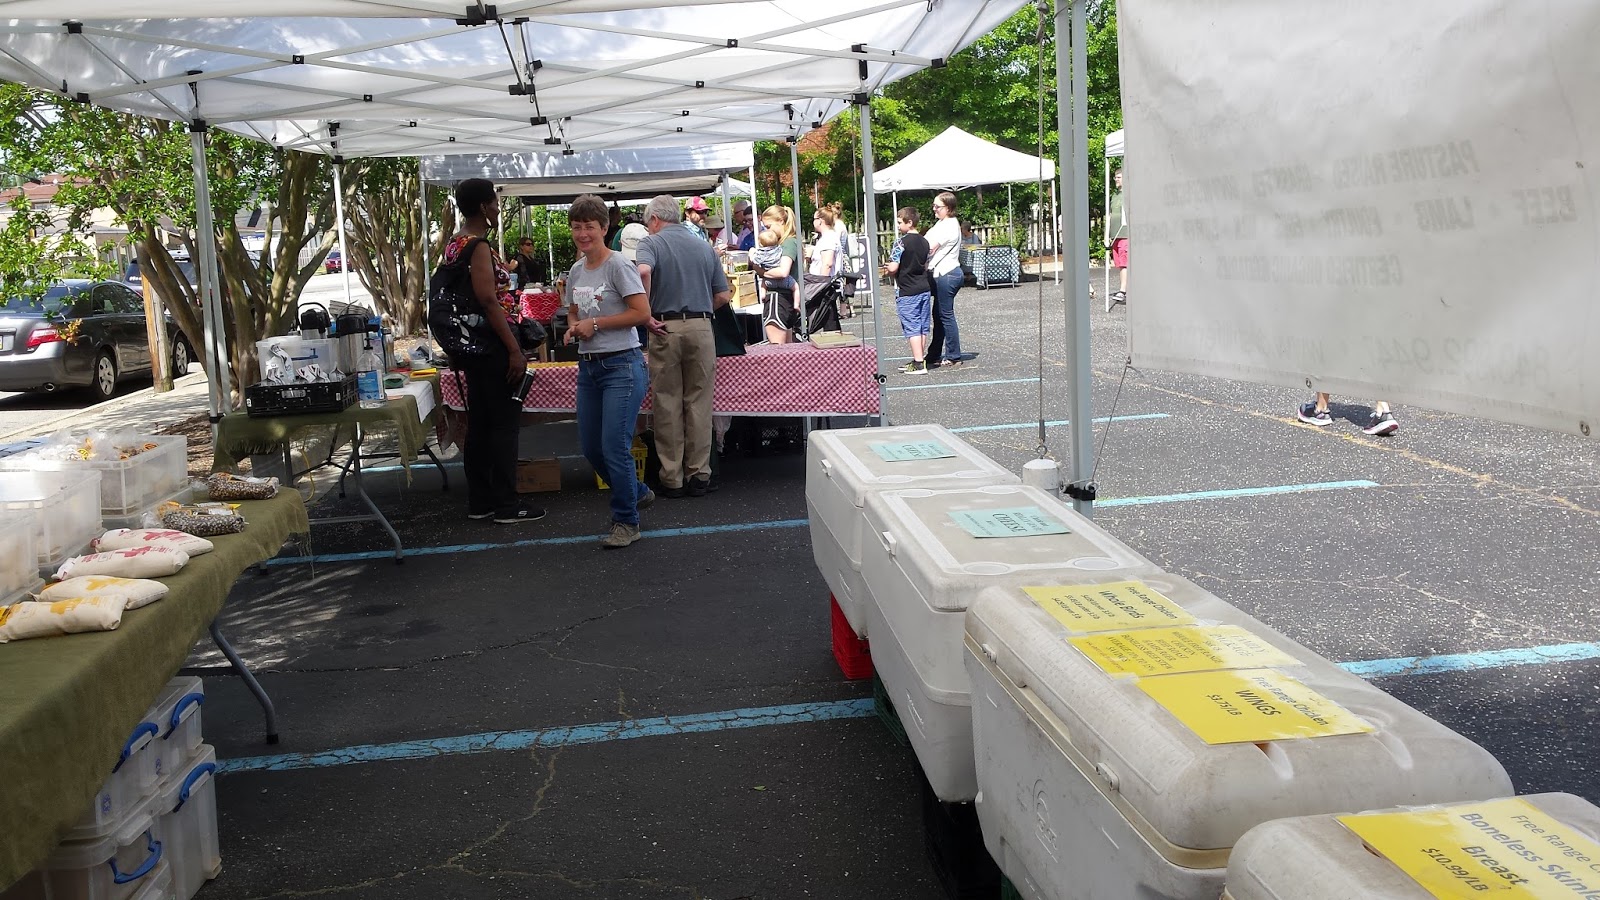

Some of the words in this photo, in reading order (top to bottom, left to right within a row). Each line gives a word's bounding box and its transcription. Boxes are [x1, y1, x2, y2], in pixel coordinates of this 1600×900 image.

[1098, 591, 1126, 606] Whole
[1120, 603, 1145, 619] Birds
[1235, 689, 1281, 716] WINGS
[1252, 677, 1272, 688] Free
[1269, 687, 1296, 704] Range
[1294, 702, 1329, 726] Chicken
[1460, 813, 1544, 863] Boneless
[1511, 815, 1545, 834] Free
[1542, 835, 1591, 862] Range
[1420, 848, 1489, 891] $10.99/LB
[1461, 846, 1529, 885] Breast
